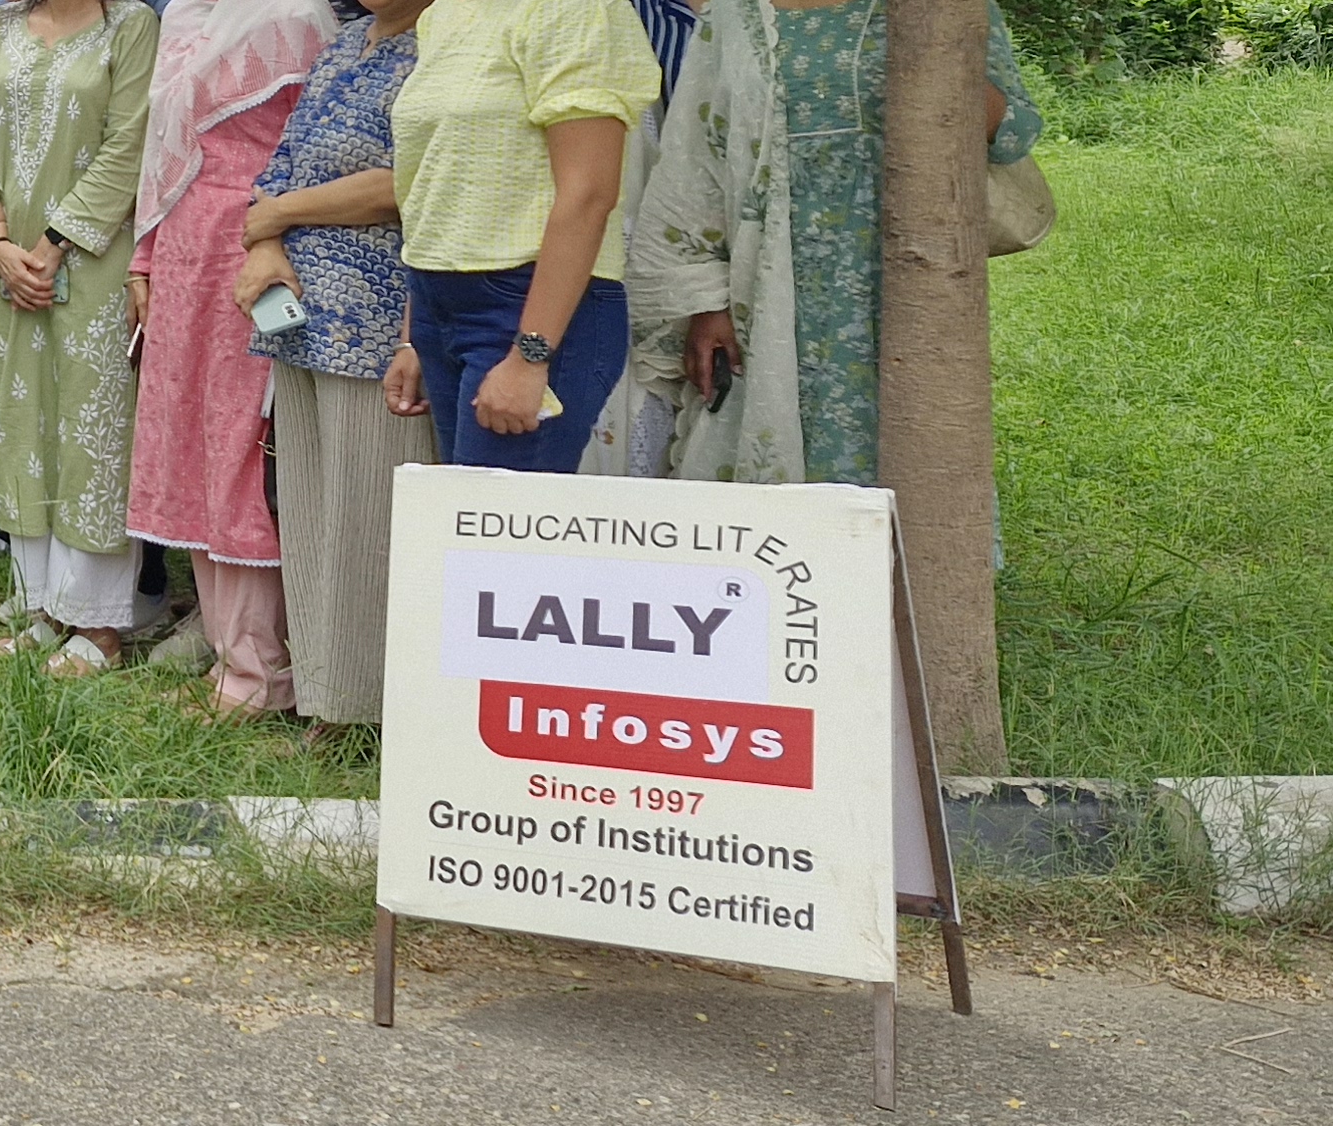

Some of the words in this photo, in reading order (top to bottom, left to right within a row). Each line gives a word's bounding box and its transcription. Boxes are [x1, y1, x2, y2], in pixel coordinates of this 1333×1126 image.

[455, 510, 679, 549] EDUCATING
[693, 523, 819, 685] LITERATES
[476, 590, 732, 657] LALLY
[507, 695, 786, 764] Infosys
[527, 774, 617, 806] Since
[630, 785, 704, 816] 1997
[428, 799, 539, 842] Group
[550, 815, 588, 846] of
[598, 818, 815, 873] Institutions
[428, 855, 484, 888] ISO
[493, 863, 658, 911] 9001-2015
[668, 885, 815, 933] Certified
